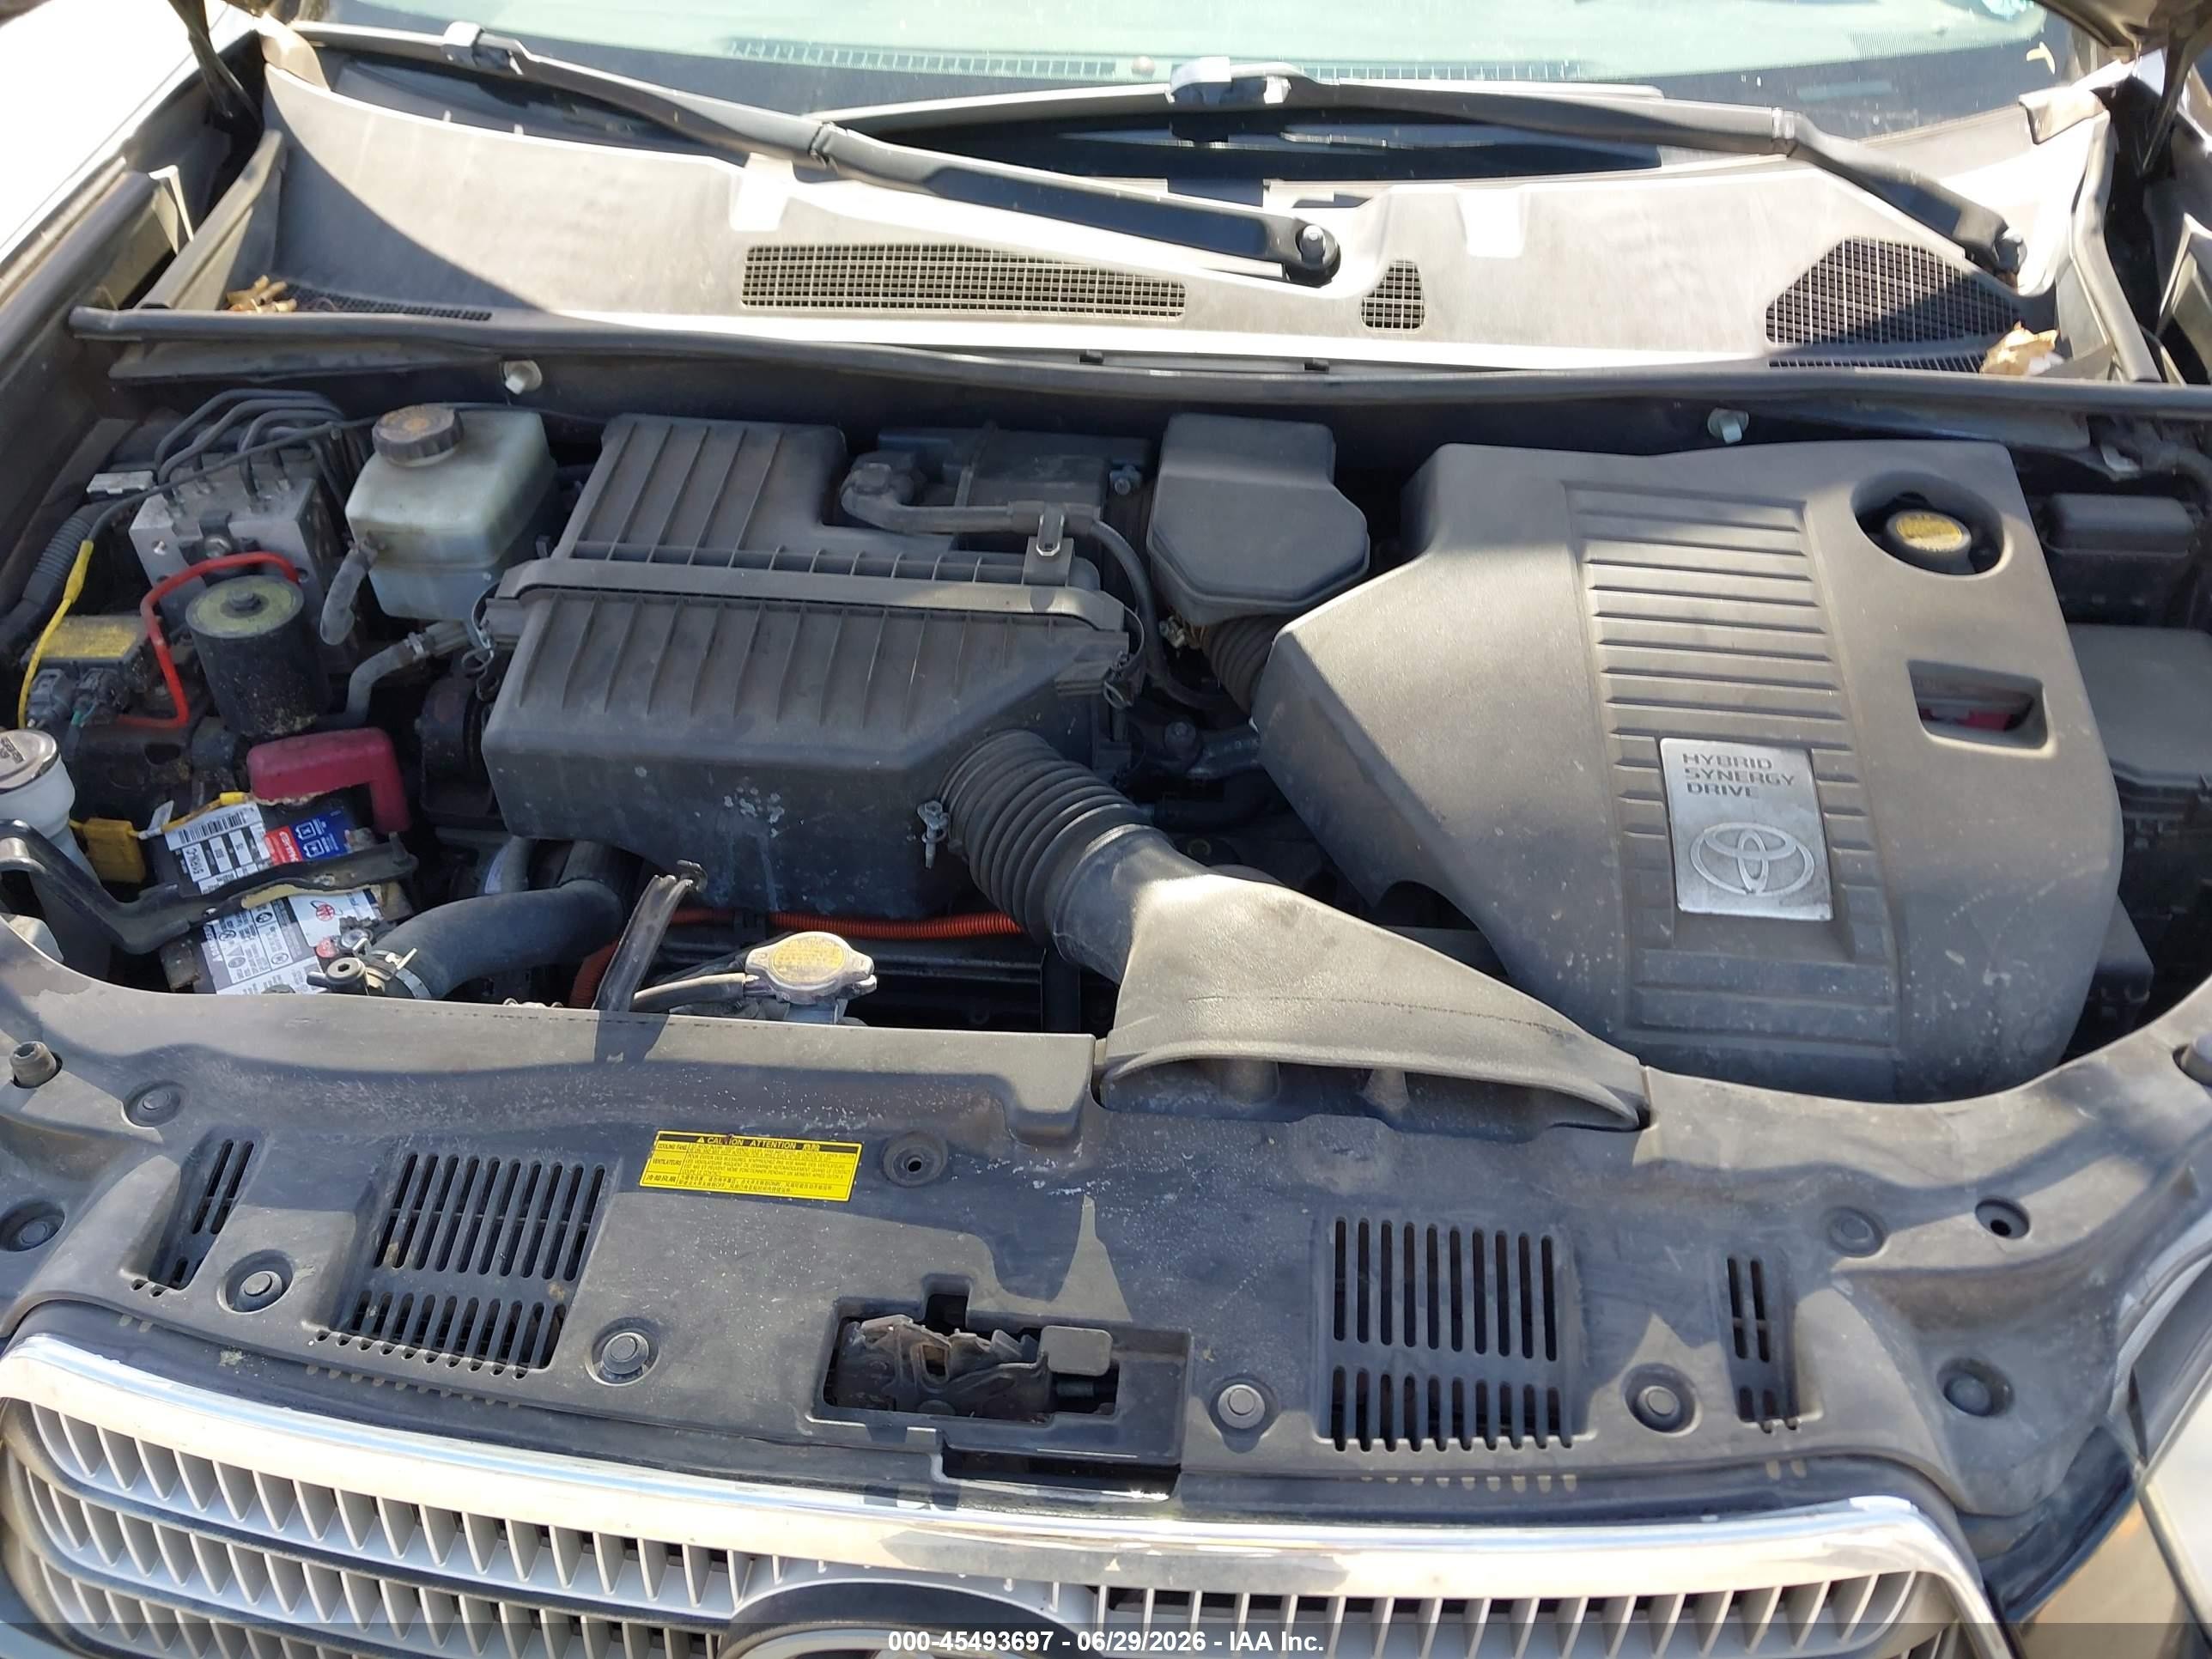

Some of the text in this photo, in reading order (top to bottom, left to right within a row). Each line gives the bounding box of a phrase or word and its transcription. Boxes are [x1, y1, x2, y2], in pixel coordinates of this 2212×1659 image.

[1682, 753, 1773, 769] HYBRID
[1684, 767, 1795, 786] SYNERGY
[1686, 782, 1759, 799] DRIVE
[749, 1139, 797, 1150] ATTENTION
